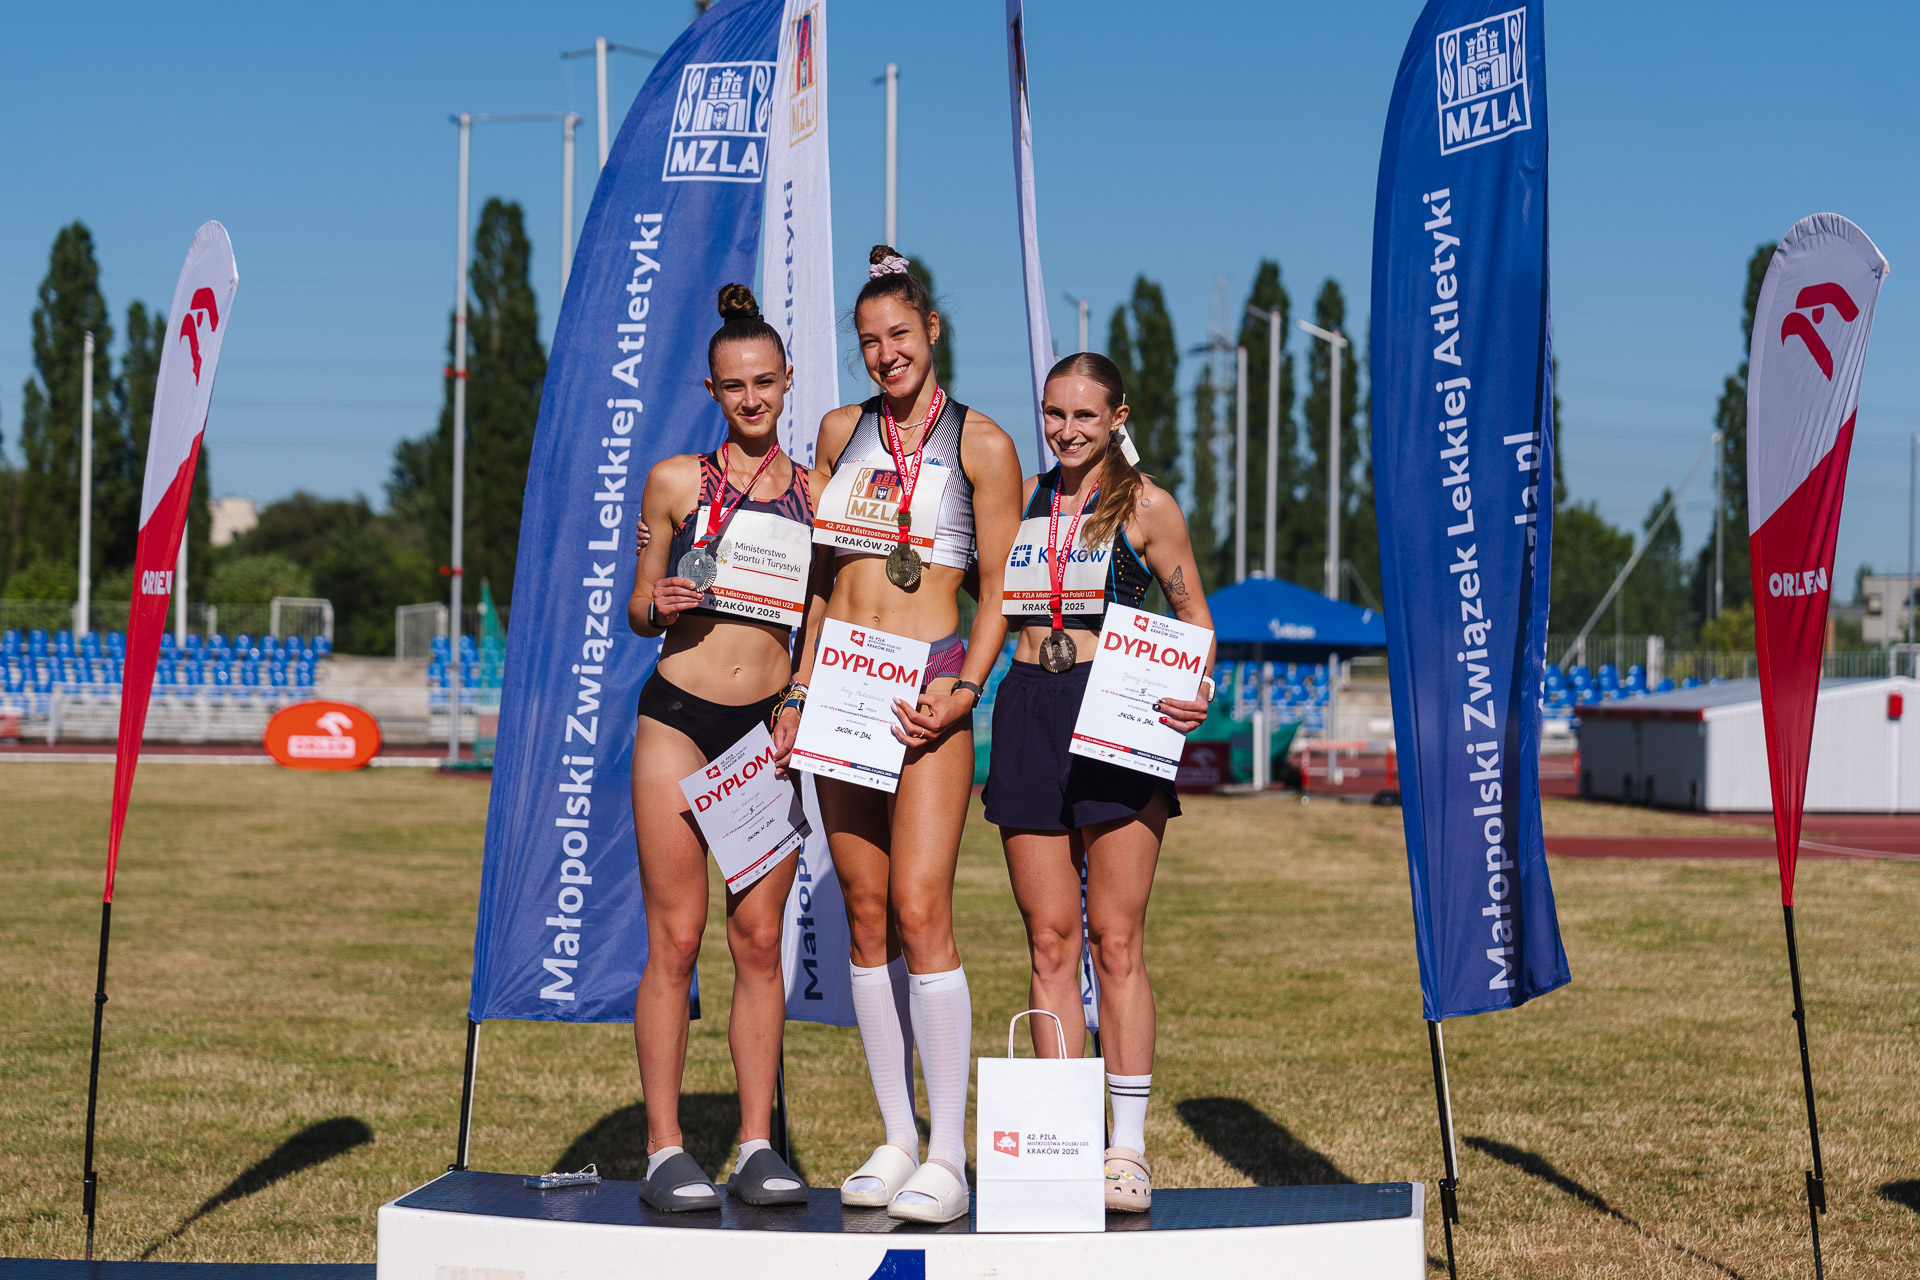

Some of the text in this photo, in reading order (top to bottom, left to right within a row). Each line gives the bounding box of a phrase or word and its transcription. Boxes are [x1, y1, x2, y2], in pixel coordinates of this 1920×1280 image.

[1446, 92, 1520, 144] MZLA
[669, 140, 760, 173] MZLA
[905, 451, 921, 496] POLSKI 2025
[825, 522, 835, 530] 42.
[835, 523, 851, 533] PZLA
[851, 526, 890, 540] Mistrzostwa
[910, 536, 924, 545] U23
[1049, 494, 1060, 548] MISTRZOSTWA
[734, 541, 787, 560] Ministerstwo
[834, 535, 898, 552] KRAKÓW 20
[1038, 545, 1107, 565] Kków
[1061, 534, 1073, 563] POLSKI
[733, 552, 760, 566] Sportu
[766, 558, 801, 574] Turystyki
[1036, 591, 1069, 599] Mistrzwa
[1086, 590, 1096, 598] U23
[1422, 187, 1515, 990] Małopolski Związek Lekkiej Atletyki
[1769, 567, 1828, 598] ORLEN
[539, 213, 663, 1001] Małopolski Związek Lekkiej Atletyki
[708, 598, 781, 620] KRAKÓW 2025
[725, 590, 763, 603] Mistrzostwa
[764, 597, 782, 607] Polski
[782, 601, 794, 609] U23
[1022, 602, 1085, 611] KRAK 2025
[821, 646, 919, 688] DYPLOM
[1103, 631, 1201, 675] DYPLOM
[694, 745, 776, 813] DYPLOM
[1026, 1147, 1060, 1155] KRAKÓW
